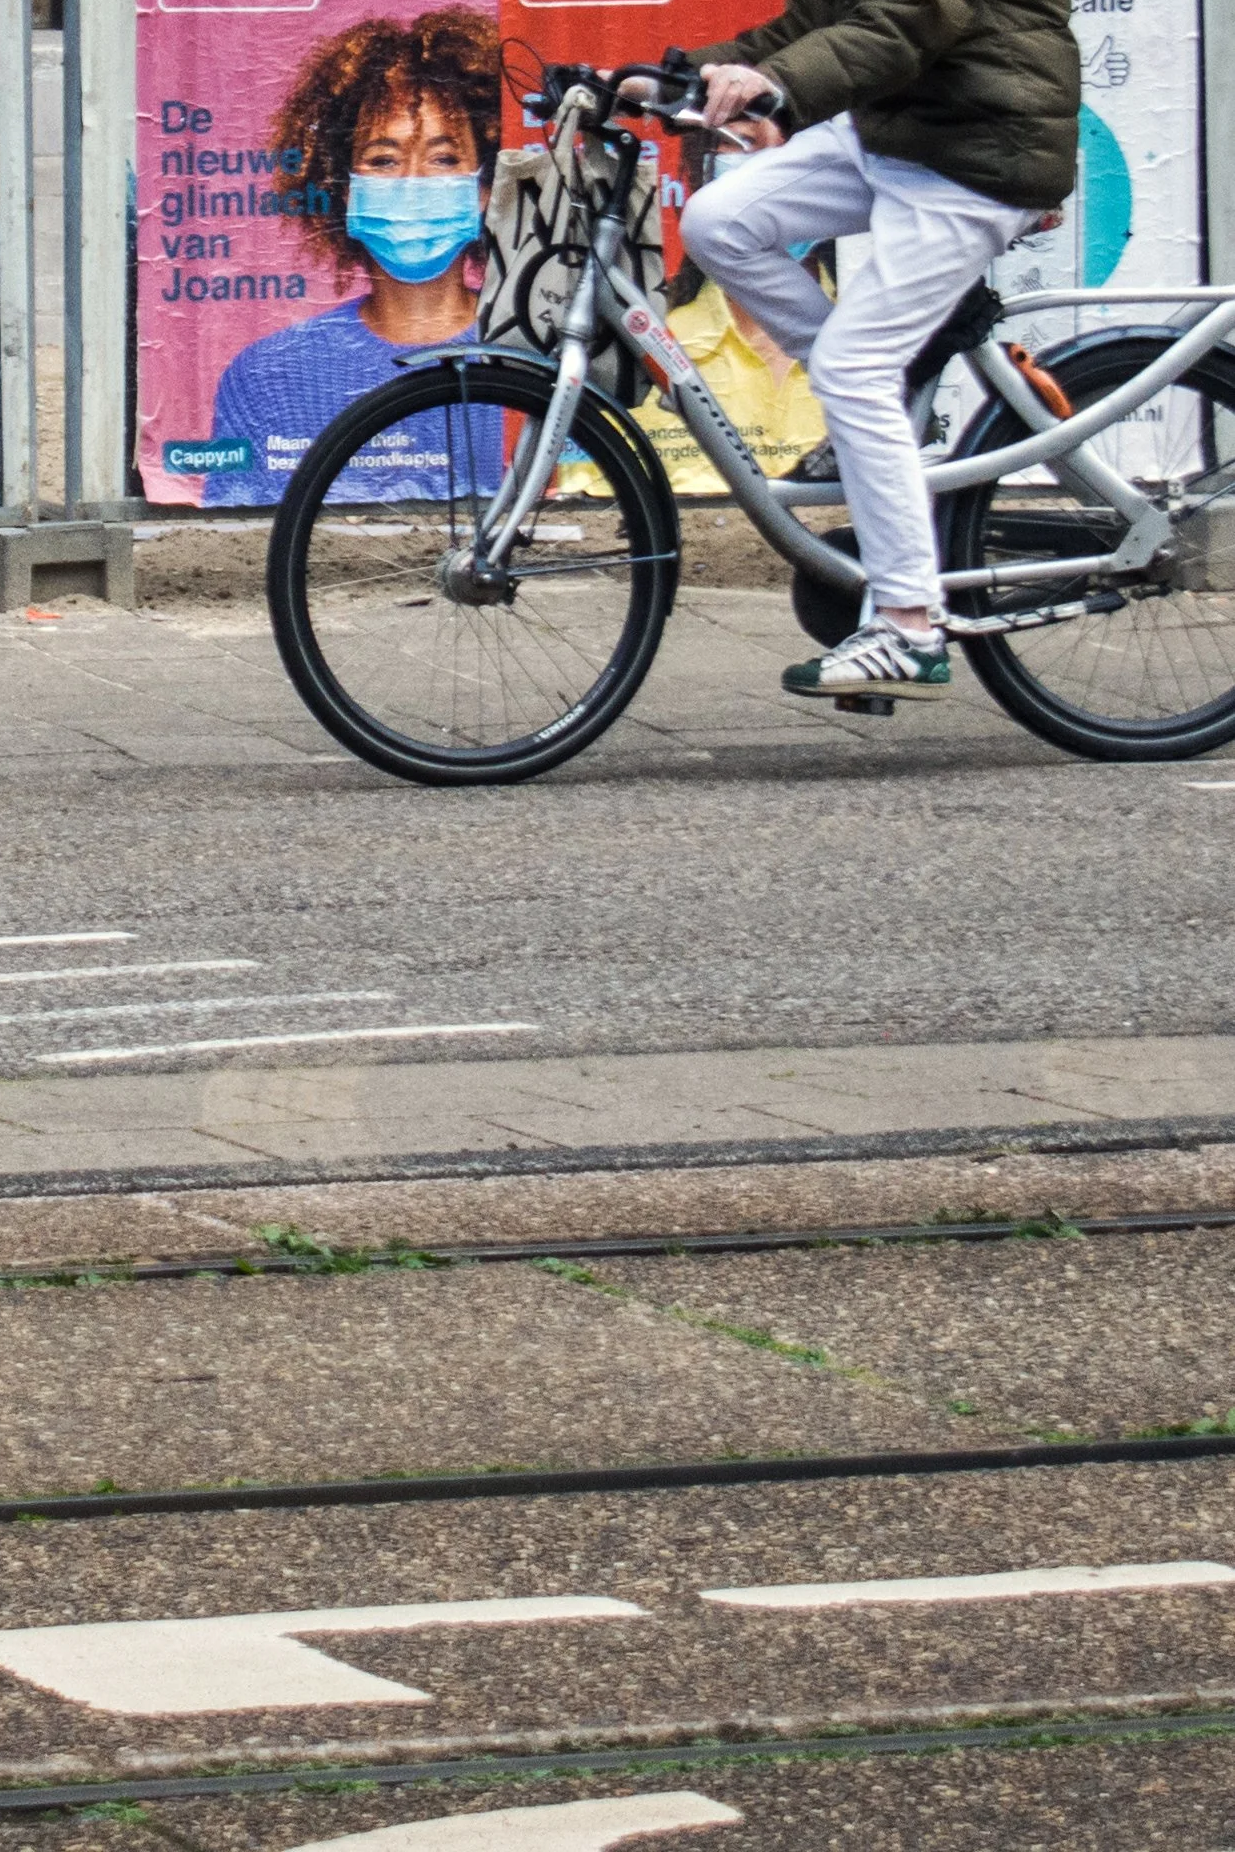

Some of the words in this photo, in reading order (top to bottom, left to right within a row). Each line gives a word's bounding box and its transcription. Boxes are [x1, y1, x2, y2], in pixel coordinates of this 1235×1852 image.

[161, 100, 212, 134] De
[161, 142, 303, 176] nieuwe
[161, 180, 331, 226] glimlach
[161, 233, 230, 260] van
[162, 267, 307, 302] Joanna
[169, 447, 245, 467] Cappy.nl
